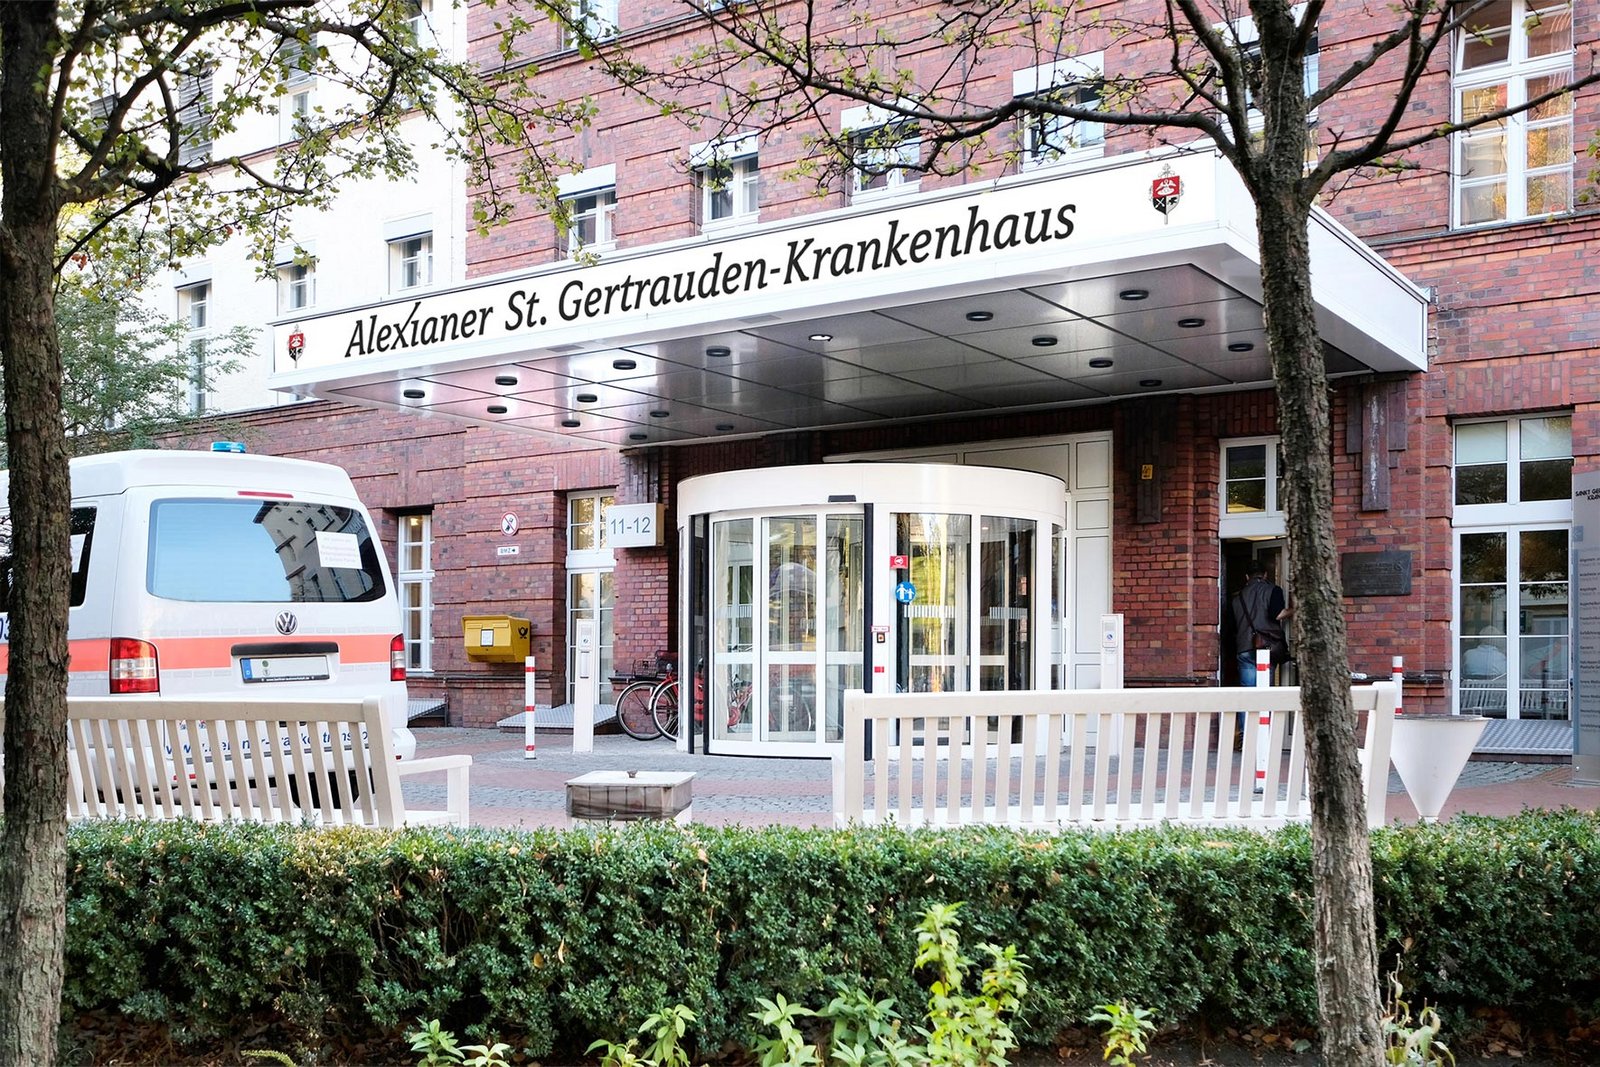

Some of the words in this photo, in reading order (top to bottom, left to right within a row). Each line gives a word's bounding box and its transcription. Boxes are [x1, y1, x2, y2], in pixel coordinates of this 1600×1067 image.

[344, 300, 494, 358] Alexianer
[504, 290, 548, 331] St.
[558, 203, 1077, 322] Gertrauden-Krankenhaus
[610, 516, 651, 535] 11-12
